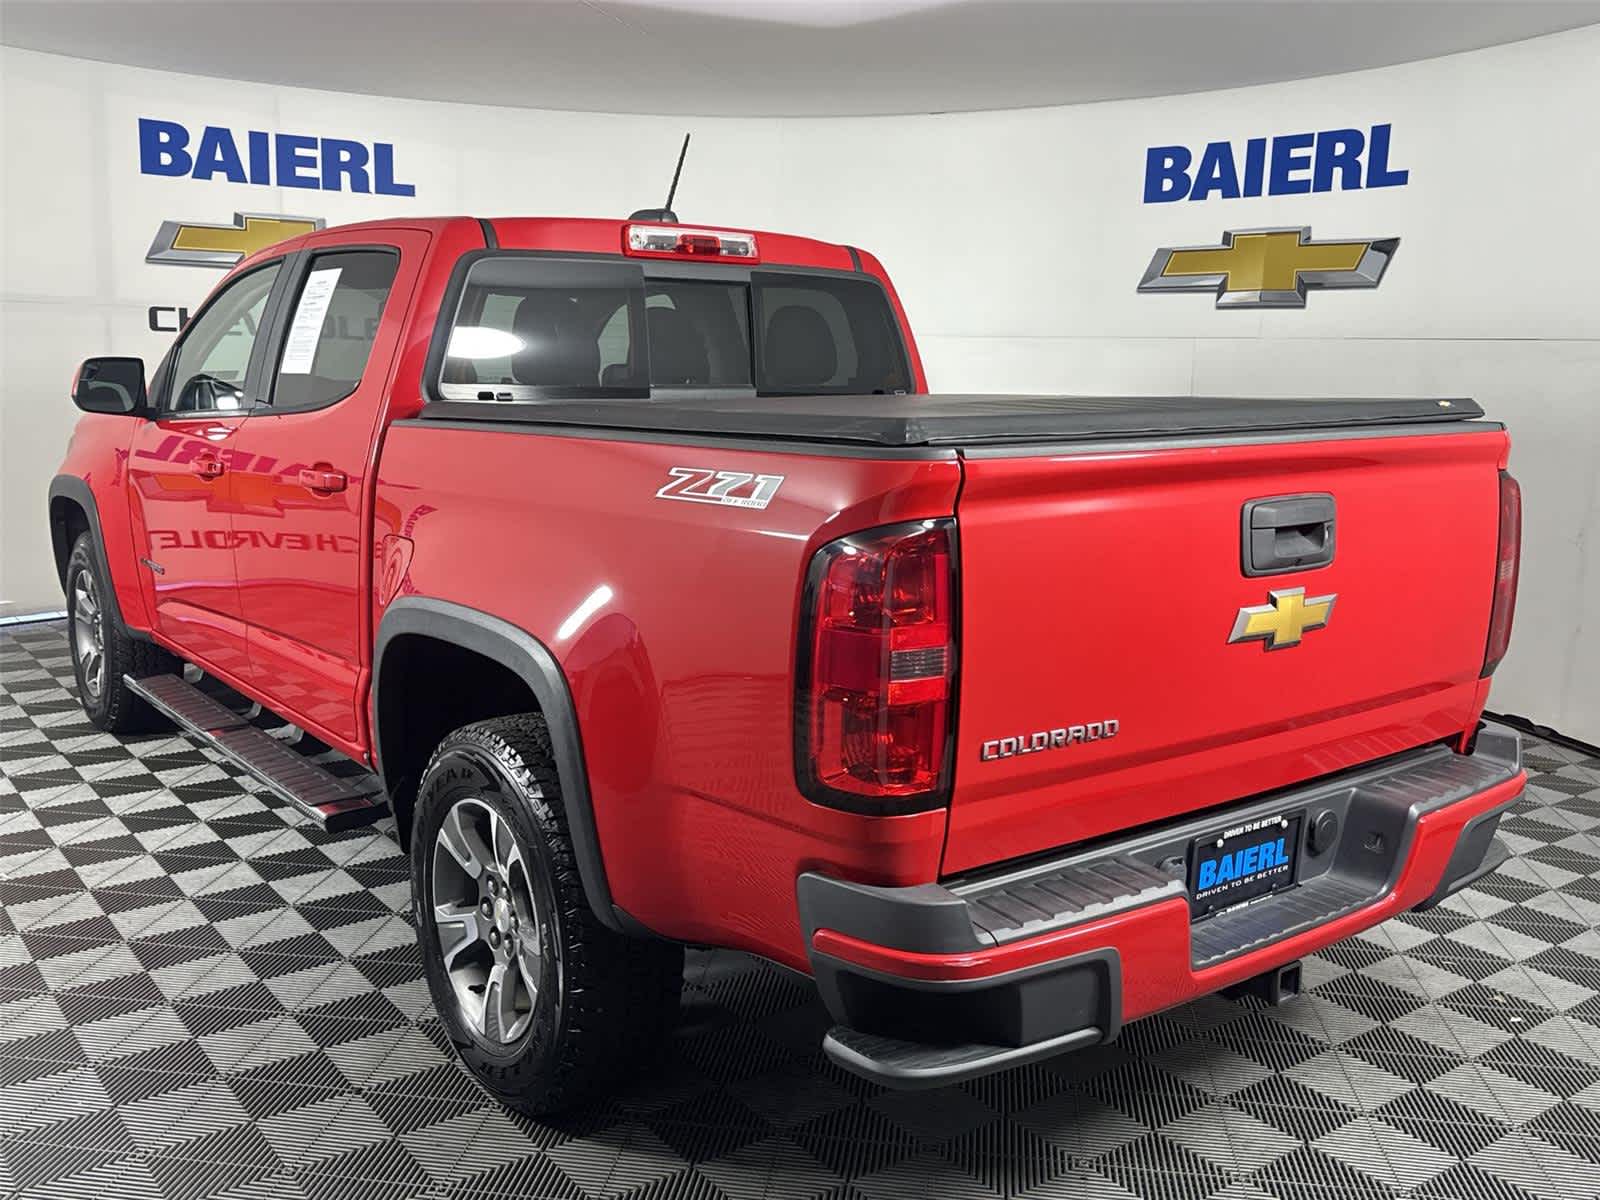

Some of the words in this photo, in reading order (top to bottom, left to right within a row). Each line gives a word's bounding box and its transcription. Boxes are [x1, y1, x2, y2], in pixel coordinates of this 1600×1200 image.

[138, 118, 416, 197] BAIERL
[1143, 123, 1409, 204] BAIERL
[656, 467, 784, 509] Z71
[981, 719, 1120, 761] COLORADO
[1223, 826, 1244, 839] DRIVEN
[1245, 823, 1253, 833] TO
[1253, 821, 1260, 830] BE
[1196, 884, 1228, 900] DRIVEN
[1231, 879, 1242, 888] TO
[1244, 875, 1255, 884] BE
[1257, 865, 1289, 879] BETTER
[1198, 838, 1289, 890] BAIERL
